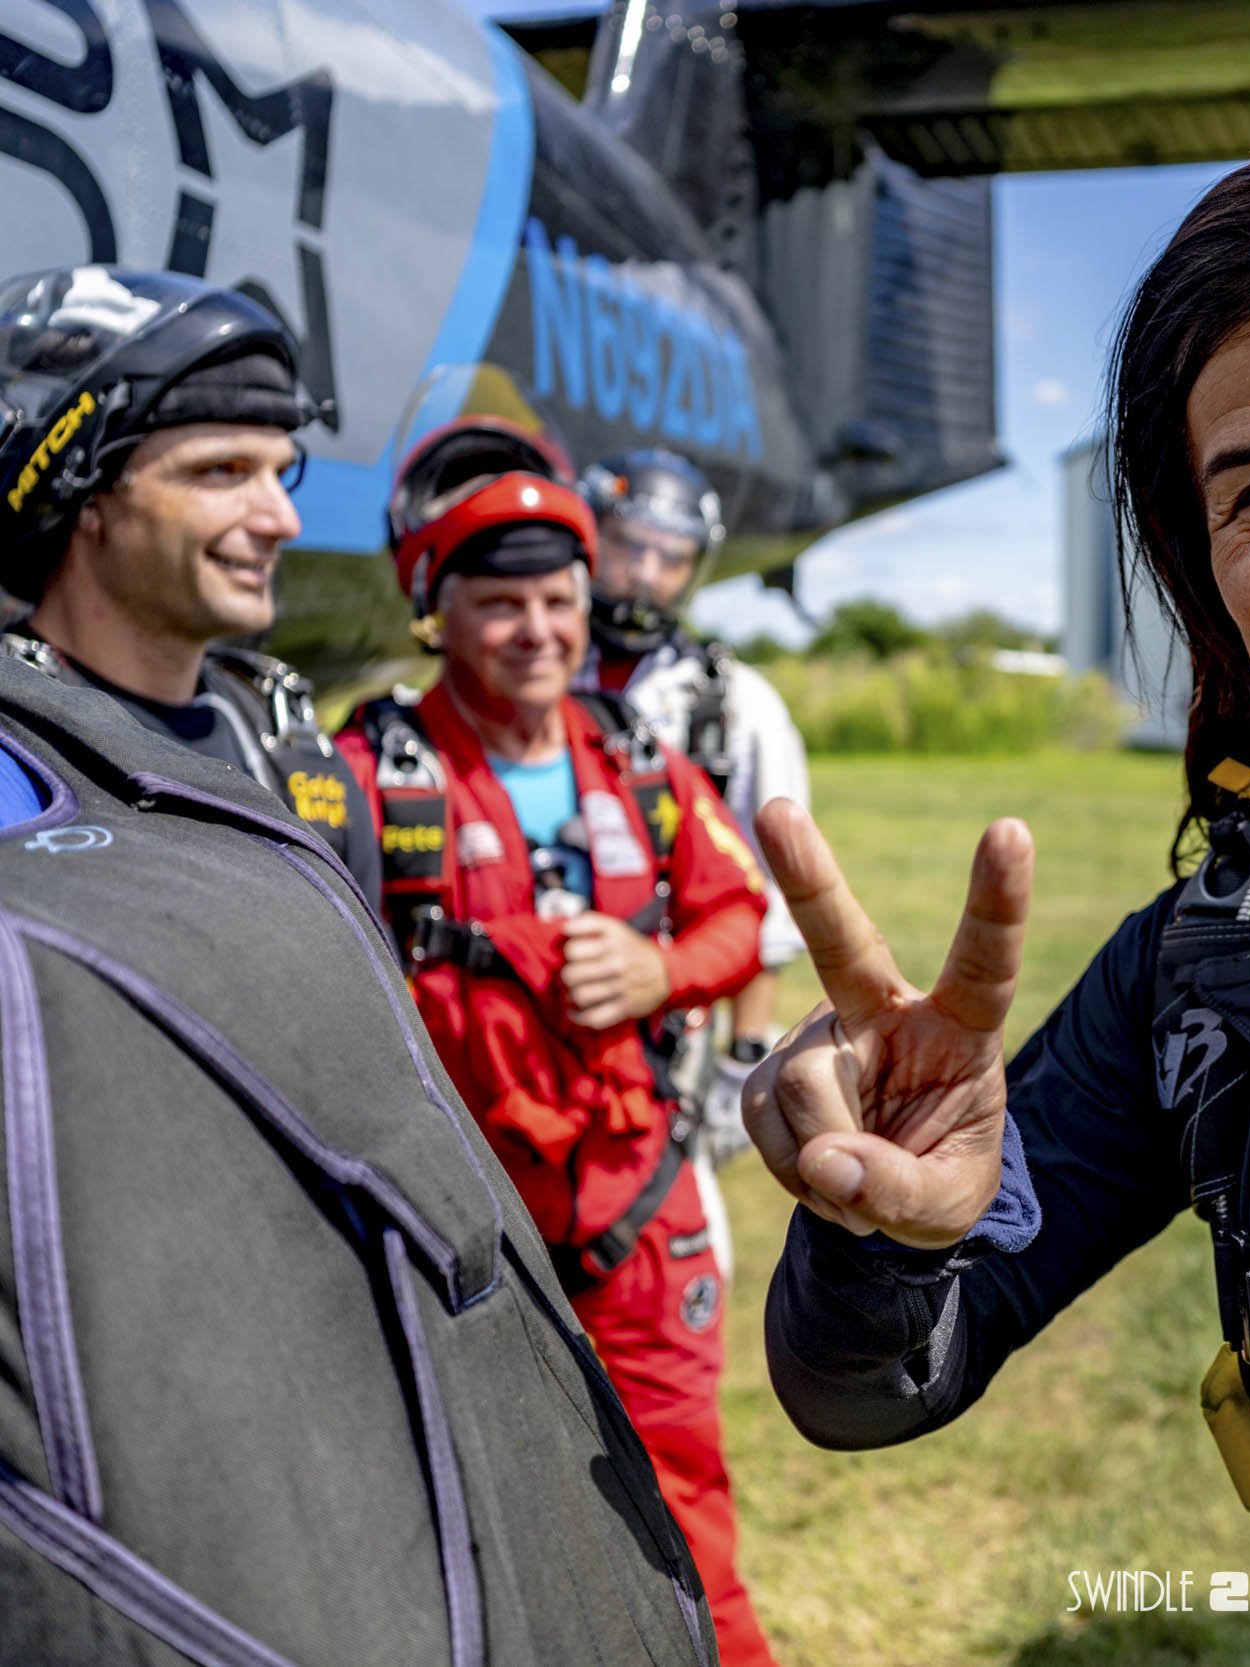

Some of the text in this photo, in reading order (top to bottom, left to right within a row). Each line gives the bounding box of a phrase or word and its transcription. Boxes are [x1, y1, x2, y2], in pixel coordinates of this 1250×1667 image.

[525, 215, 763, 461] N692DA
[7, 391, 95, 513] MITCH
[382, 823, 445, 854] Pete
